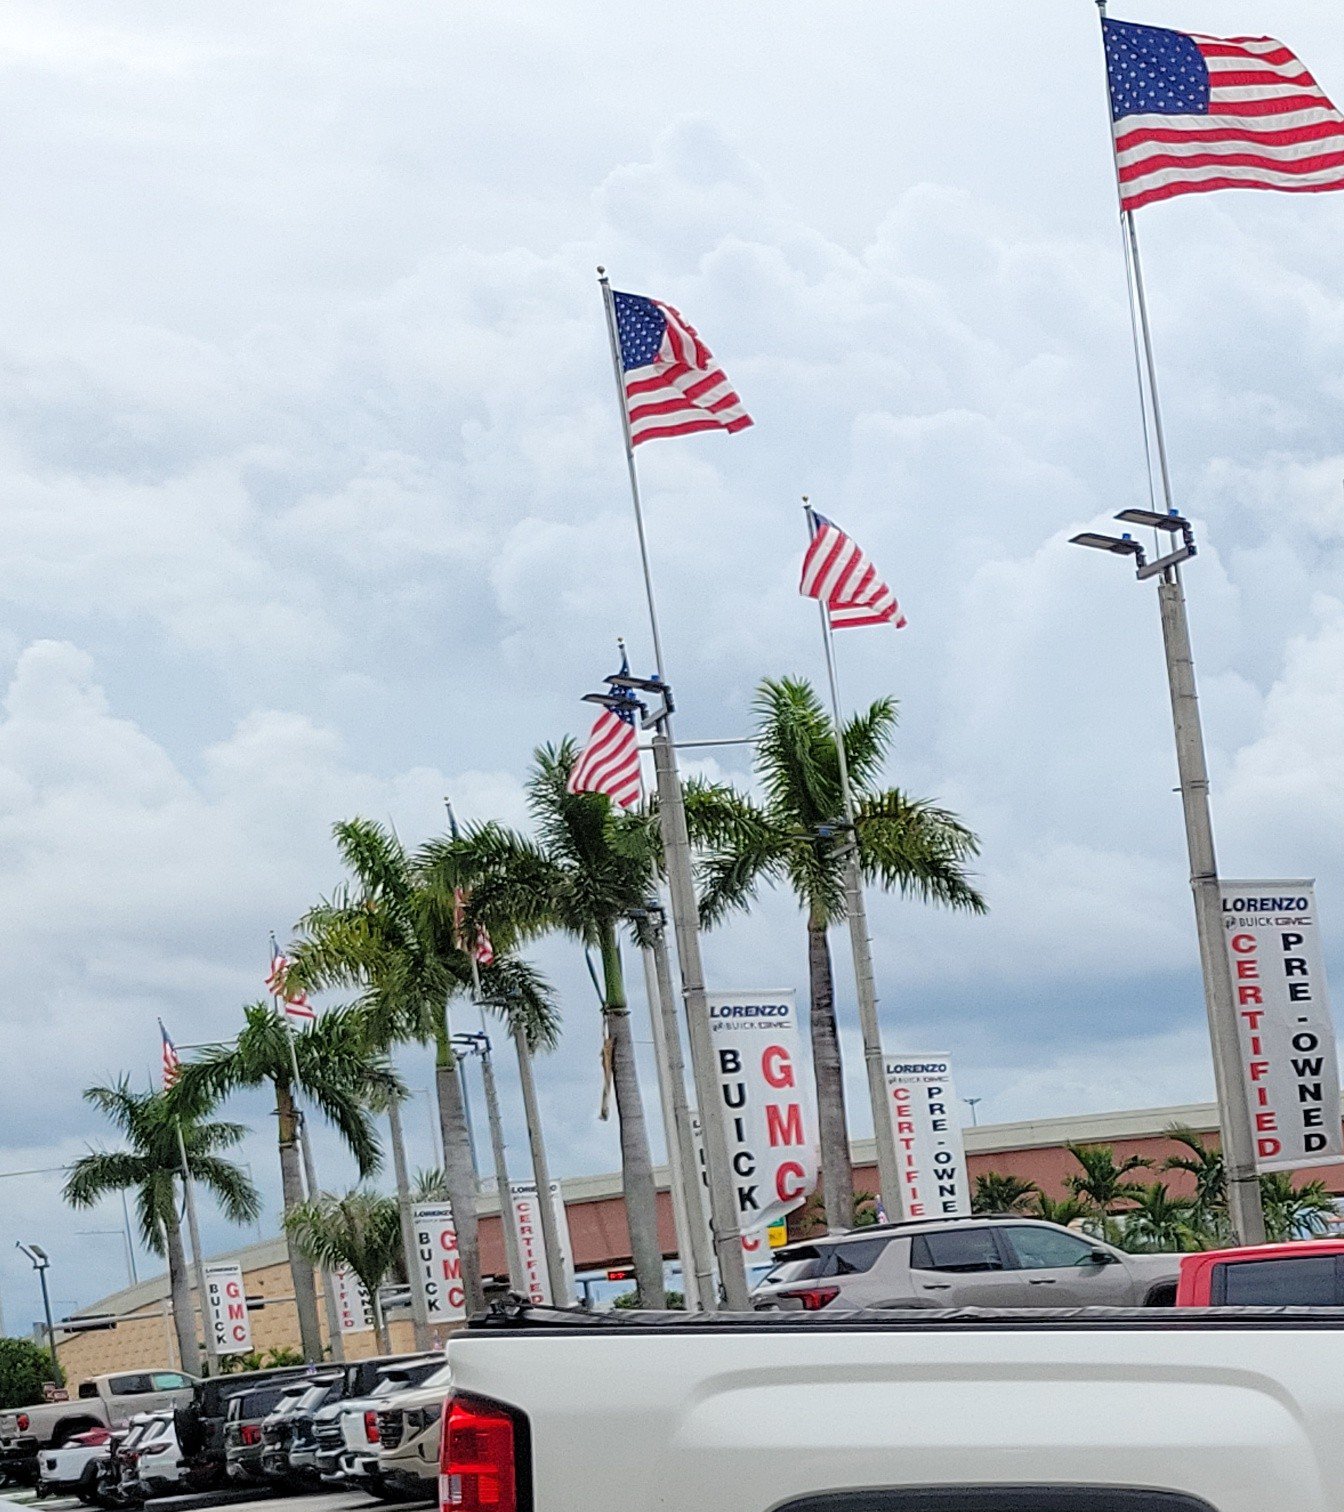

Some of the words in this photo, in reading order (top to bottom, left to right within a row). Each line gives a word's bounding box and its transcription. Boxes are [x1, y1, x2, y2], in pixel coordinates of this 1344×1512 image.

[1222, 897, 1308, 912] LORENZO
[710, 1004, 789, 1018] LORENZO
[1231, 933, 1282, 1158] CERTIFIED
[1281, 932, 1328, 1153] PRE-OWNED
[887, 1063, 947, 1074] LORENZO
[719, 1048, 761, 1213] BUICK
[761, 1045, 806, 1203] GMC
[893, 1087, 926, 1217] CERTIFIE
[927, 1086, 959, 1214] PRE-OWNE
[418, 1232, 441, 1312] BUICK
[440, 1229, 465, 1309] GMC
[517, 1202, 545, 1304] CERTIFIED
[209, 1283, 227, 1345] BUICK
[226, 1281, 247, 1343] GMC
